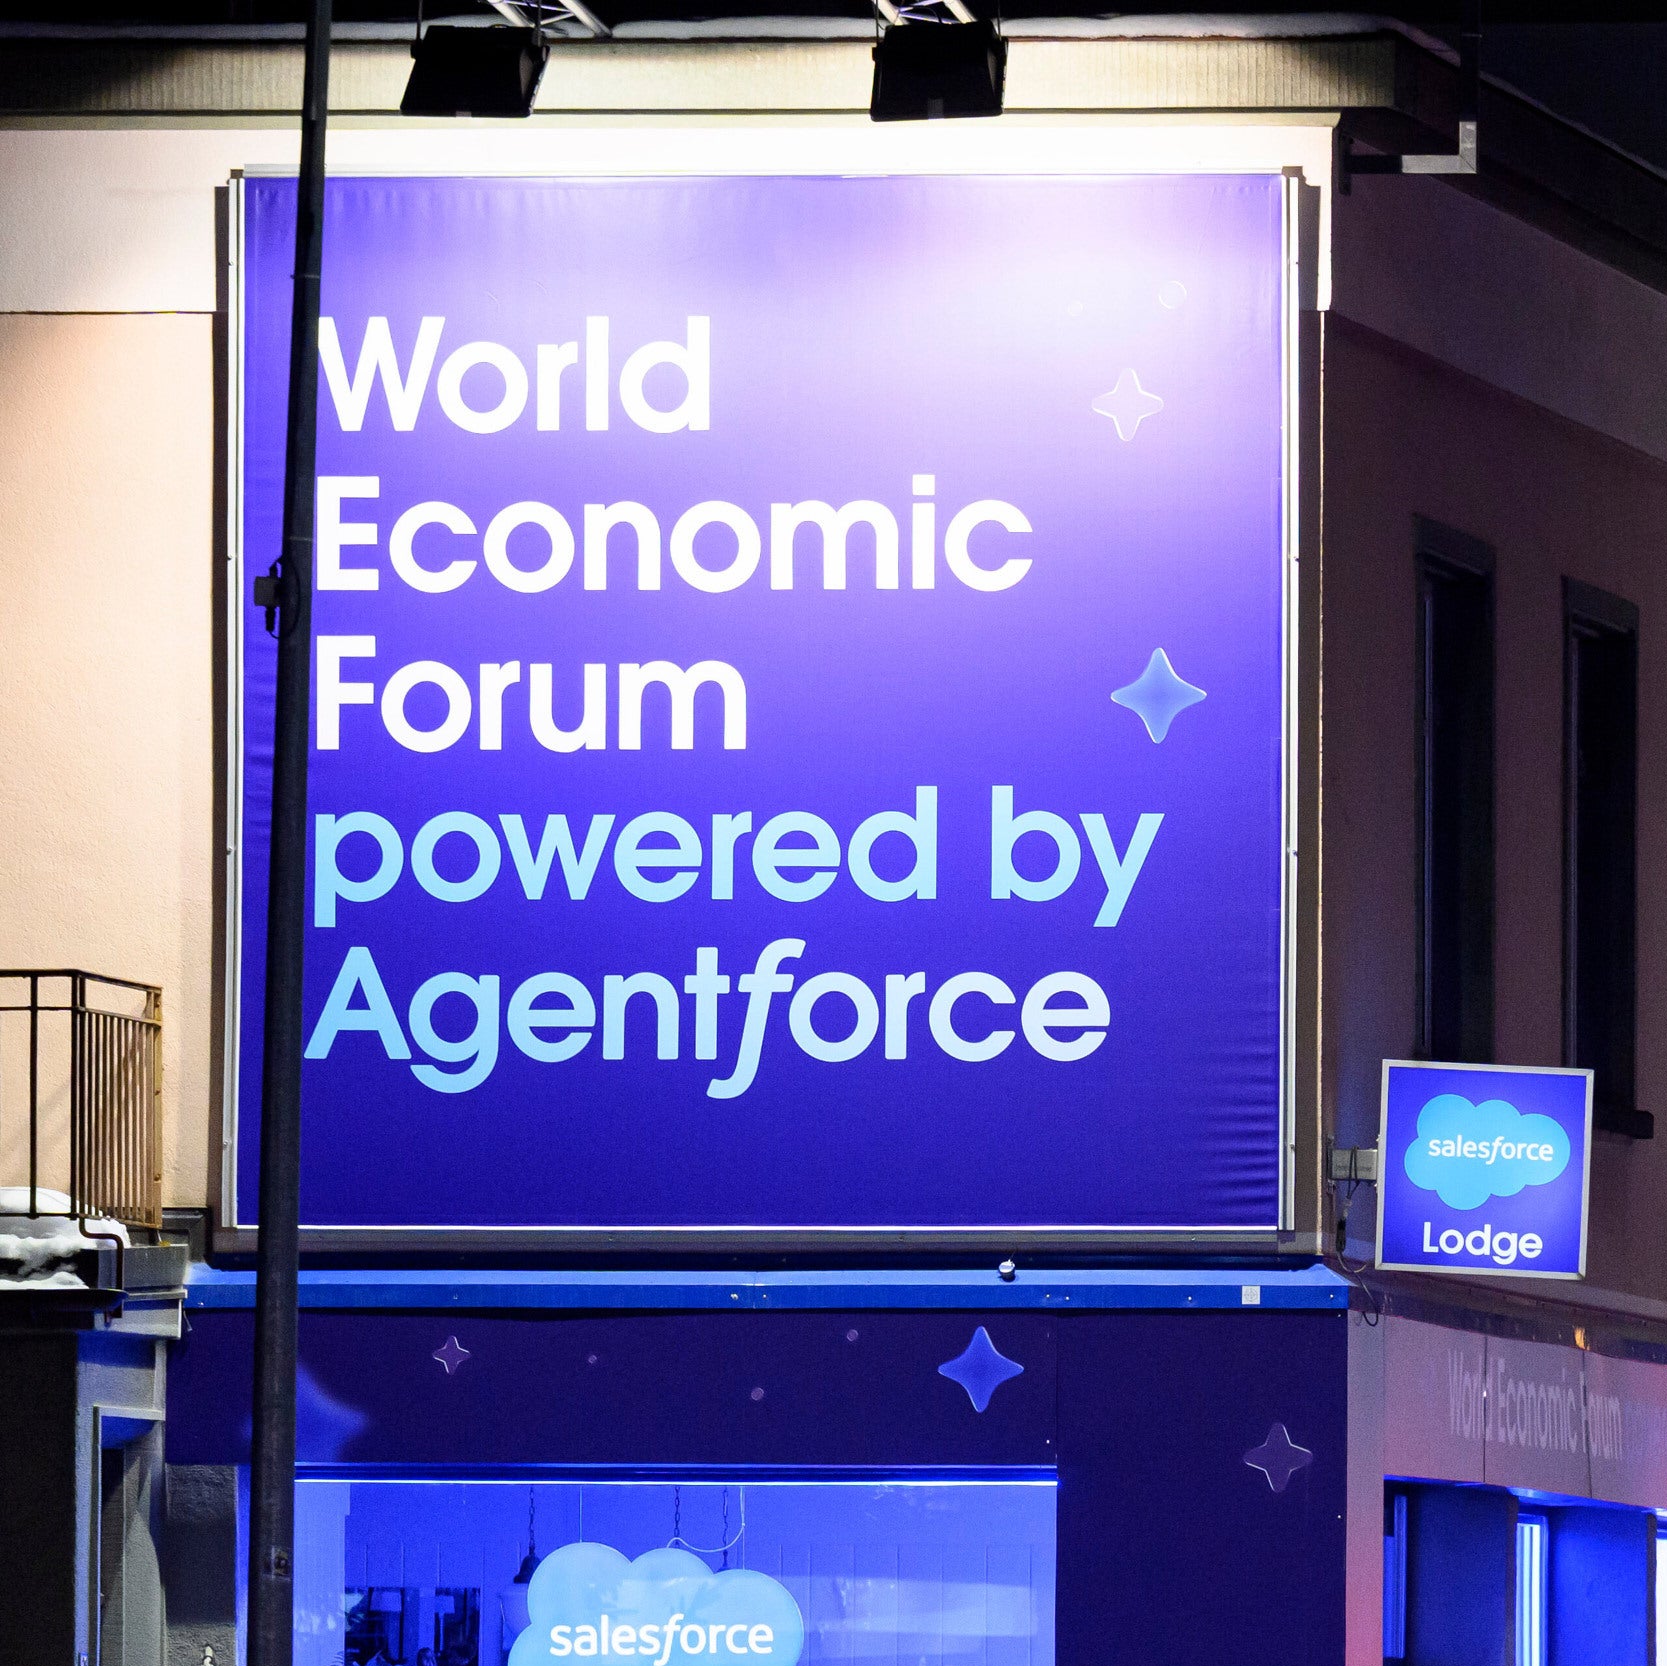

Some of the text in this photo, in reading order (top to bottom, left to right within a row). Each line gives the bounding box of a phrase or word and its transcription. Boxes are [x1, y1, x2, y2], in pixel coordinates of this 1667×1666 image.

[317, 314, 712, 434] World
[314, 473, 1033, 593] Economic
[314, 633, 747, 753] Forum
[312, 784, 1164, 929] powered by
[302, 937, 1112, 1100] Agentforce
[1427, 1131, 1555, 1165] salesforce
[1421, 1220, 1544, 1266] Lodge
[1497, 1357, 1577, 1453] Economic
[548, 1612, 775, 1666] salesforce
